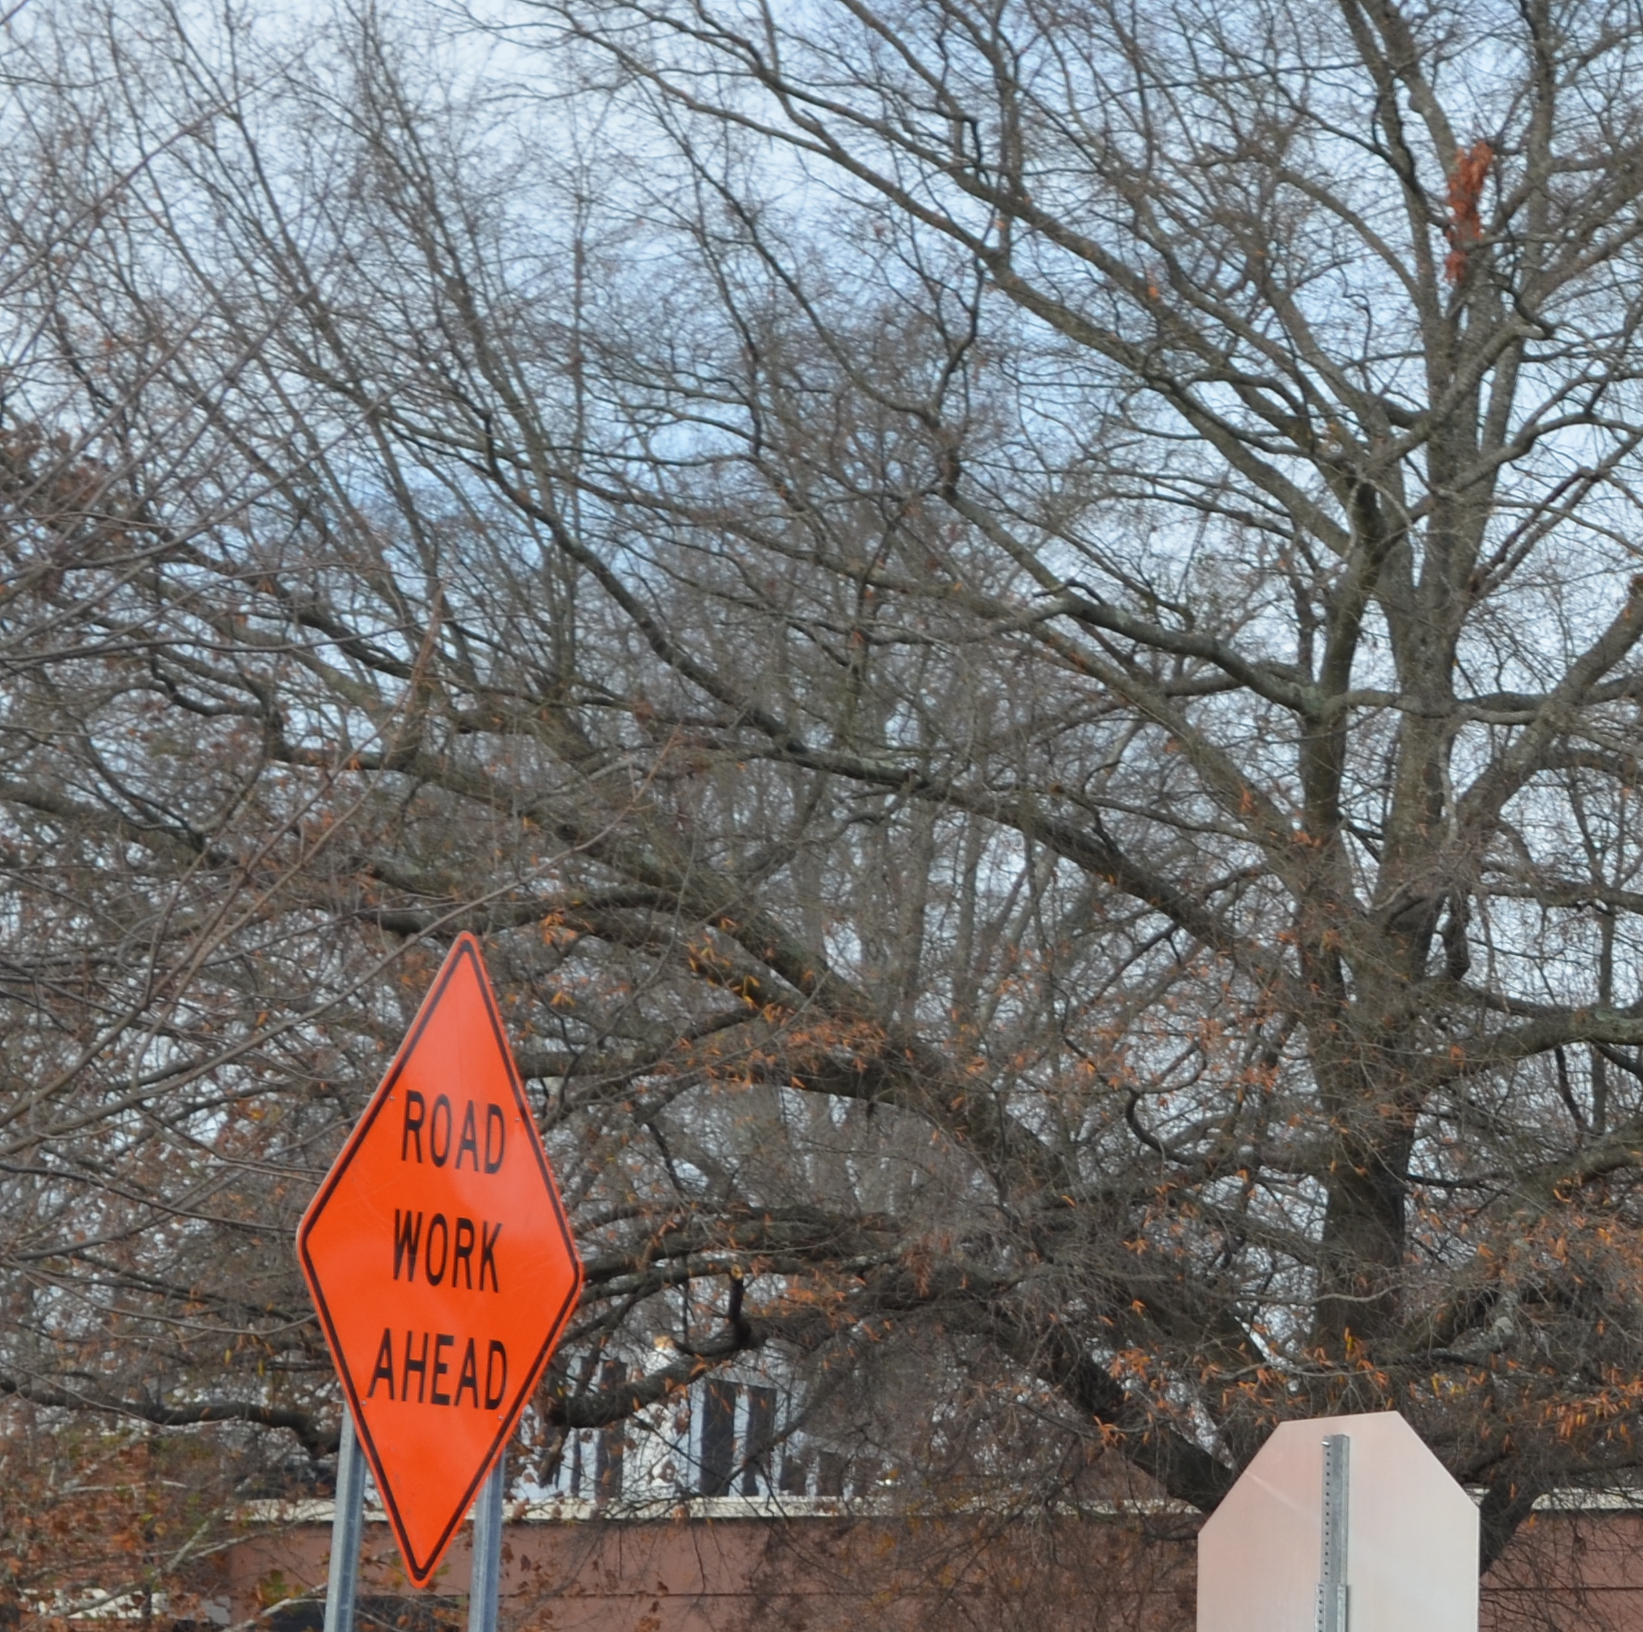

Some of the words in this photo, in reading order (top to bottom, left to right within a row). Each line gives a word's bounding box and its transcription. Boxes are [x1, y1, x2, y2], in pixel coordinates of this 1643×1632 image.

[402, 1090, 506, 1174] ROAD
[393, 1209, 503, 1293] WORK
[367, 1328, 508, 1410] AHEAD
